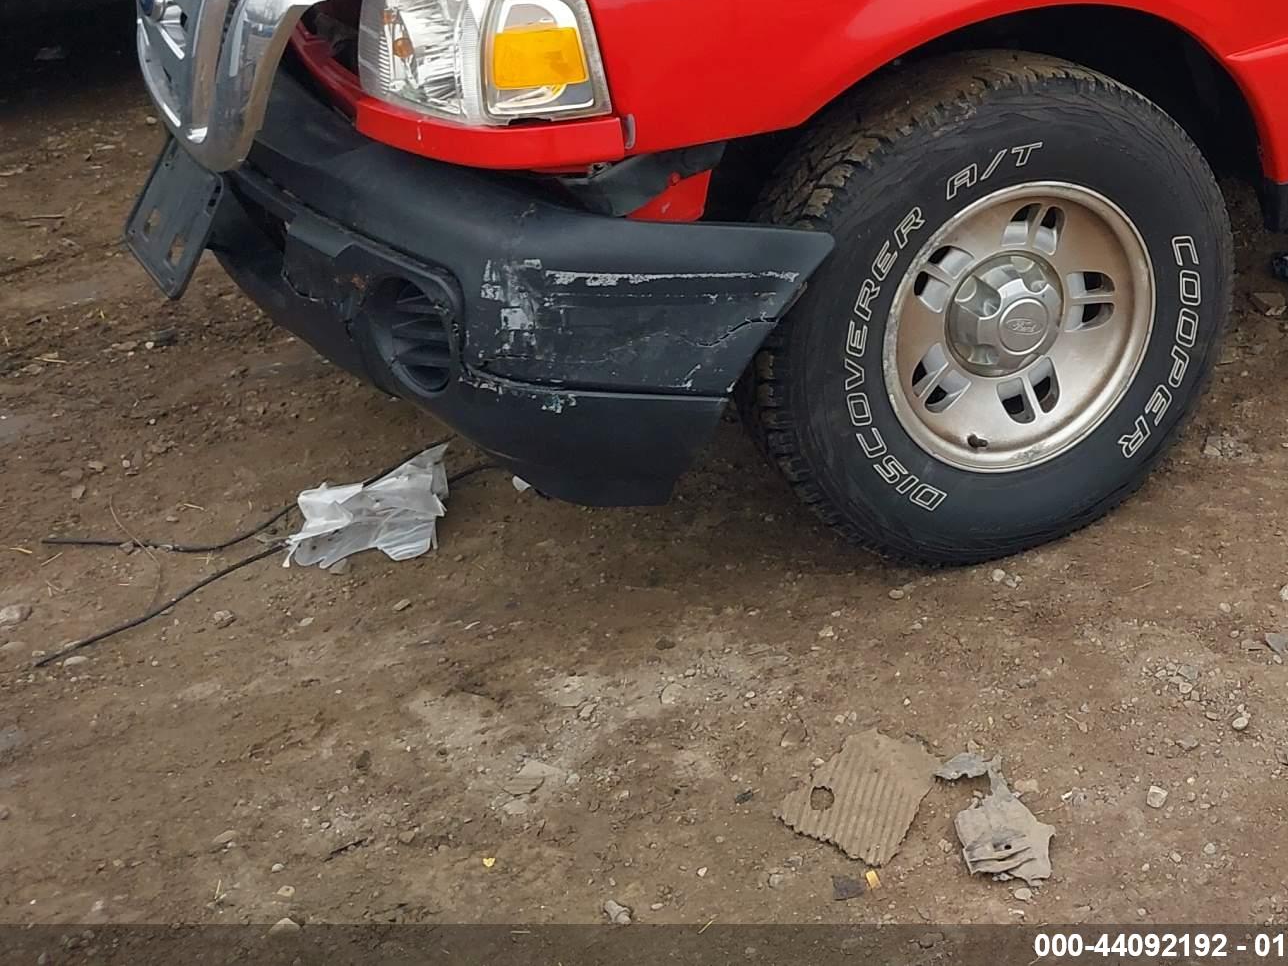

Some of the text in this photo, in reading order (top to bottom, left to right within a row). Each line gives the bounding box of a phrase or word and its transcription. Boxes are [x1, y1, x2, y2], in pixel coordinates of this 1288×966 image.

[844, 141, 1043, 512] DISCOVERER A/T
[1117, 235, 1202, 460] COOPER
